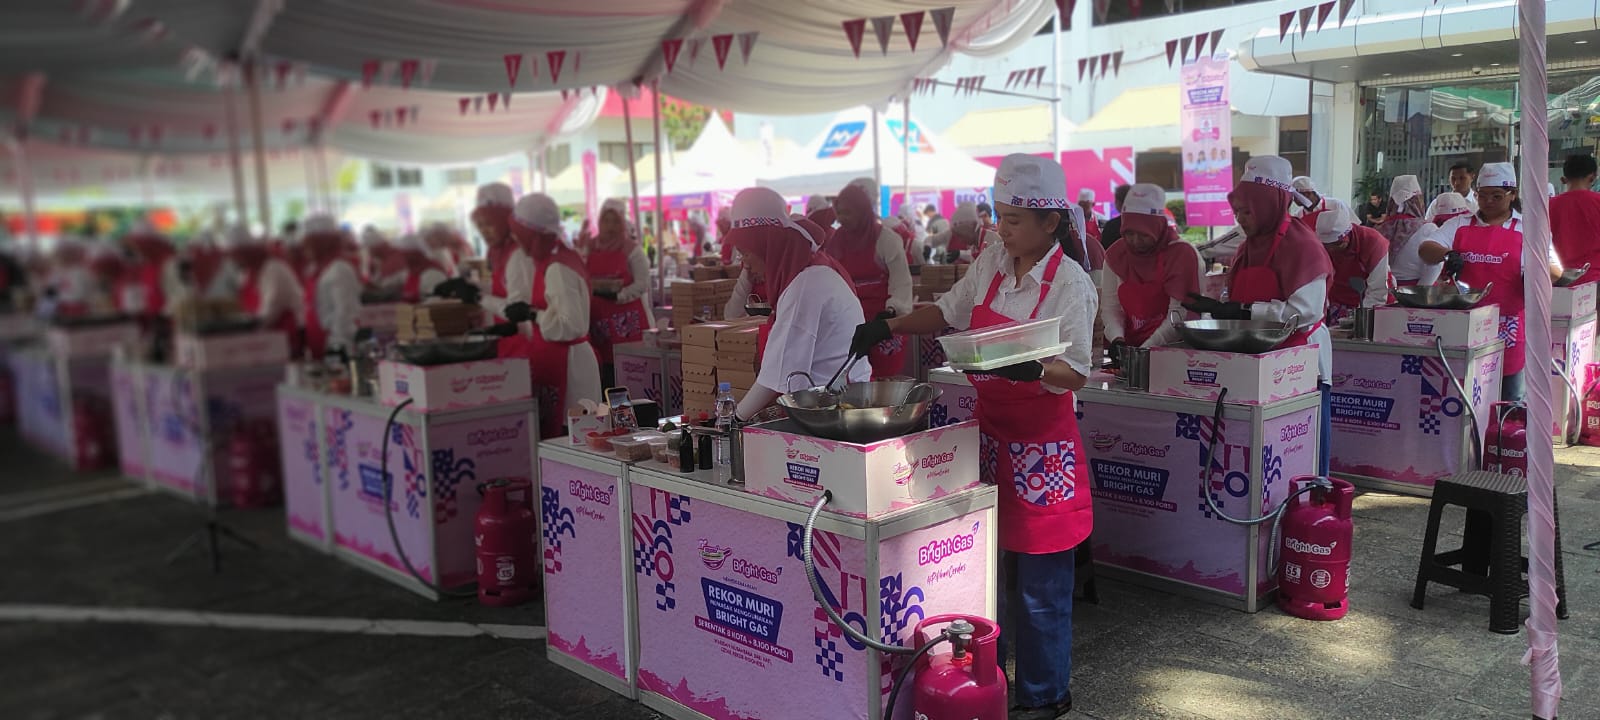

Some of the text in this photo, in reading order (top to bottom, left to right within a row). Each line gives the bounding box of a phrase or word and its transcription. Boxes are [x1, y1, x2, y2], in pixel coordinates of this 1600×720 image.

[959, 396, 977, 412] Brig
[1330, 395, 1360, 406] REKOR
[1362, 398, 1387, 408] MURI
[1335, 408, 1363, 417] BRIGHT
[1364, 411, 1381, 419] GAS
[1122, 442, 1166, 458] Bright Gas
[922, 454, 941, 469] Bright
[1097, 463, 1161, 482] REKOR MURI
[570, 480, 610, 505] Bright Gas
[1103, 480, 1154, 496] BRIGHT GAS
[918, 534, 974, 566] Bright Gas
[1285, 537, 1331, 555] Bright Gas
[733, 558, 760, 580] Bright
[760, 566, 778, 584] Gas
[708, 584, 775, 618] REKOR MURI
[715, 609, 768, 637] BRIGHT GAS
[698, 618, 726, 634] SERENTAK
[731, 632, 748, 644] KOTA
[770, 645, 789, 659] PORSI
